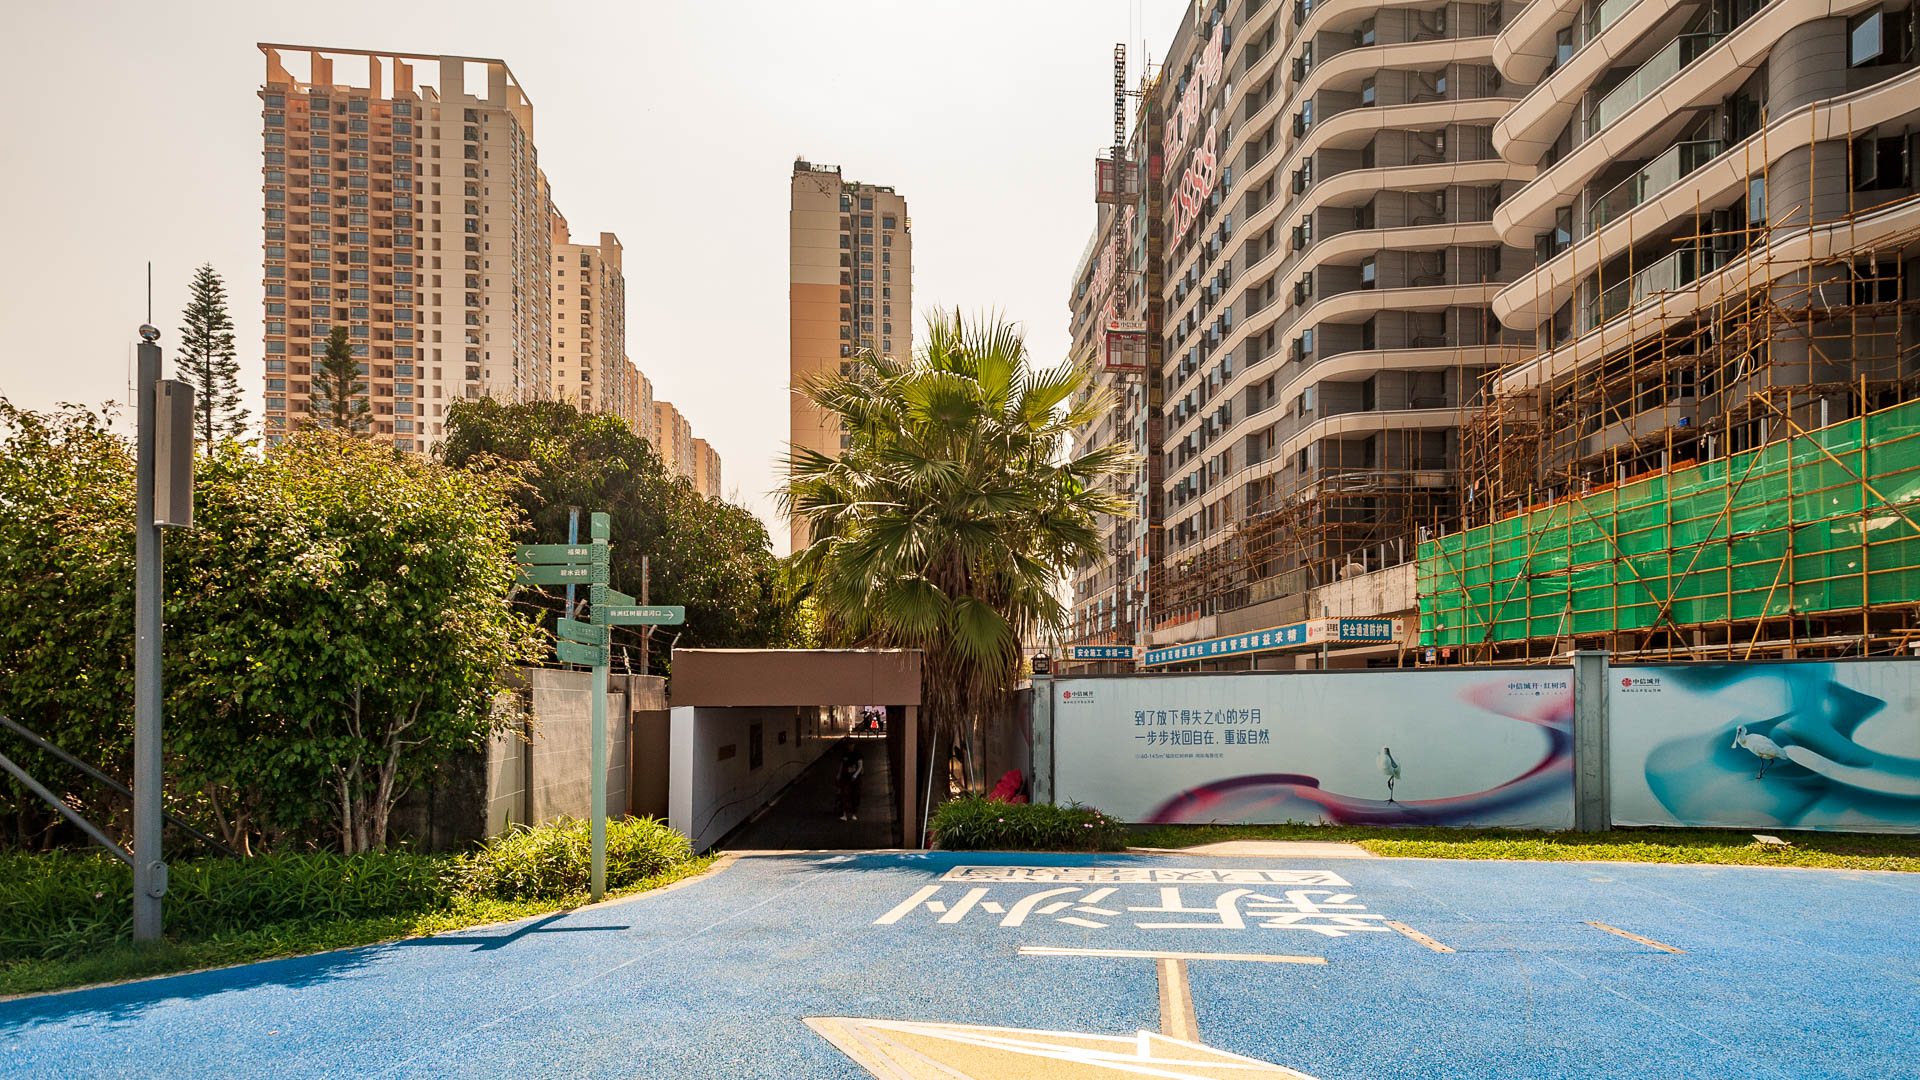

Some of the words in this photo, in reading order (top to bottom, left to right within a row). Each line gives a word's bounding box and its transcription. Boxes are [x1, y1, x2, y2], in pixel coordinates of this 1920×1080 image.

[1170, 126, 1216, 254] 1888
[1210, 628, 1297, 654] 质量管理精益求精
[1342, 623, 1390, 637] 安全通道防护棚
[1077, 648, 1103, 657] 安全施工
[1134, 708, 1262, 726] 到了放下得失之心的岁月
[872, 885, 1392, 937] 新洲
